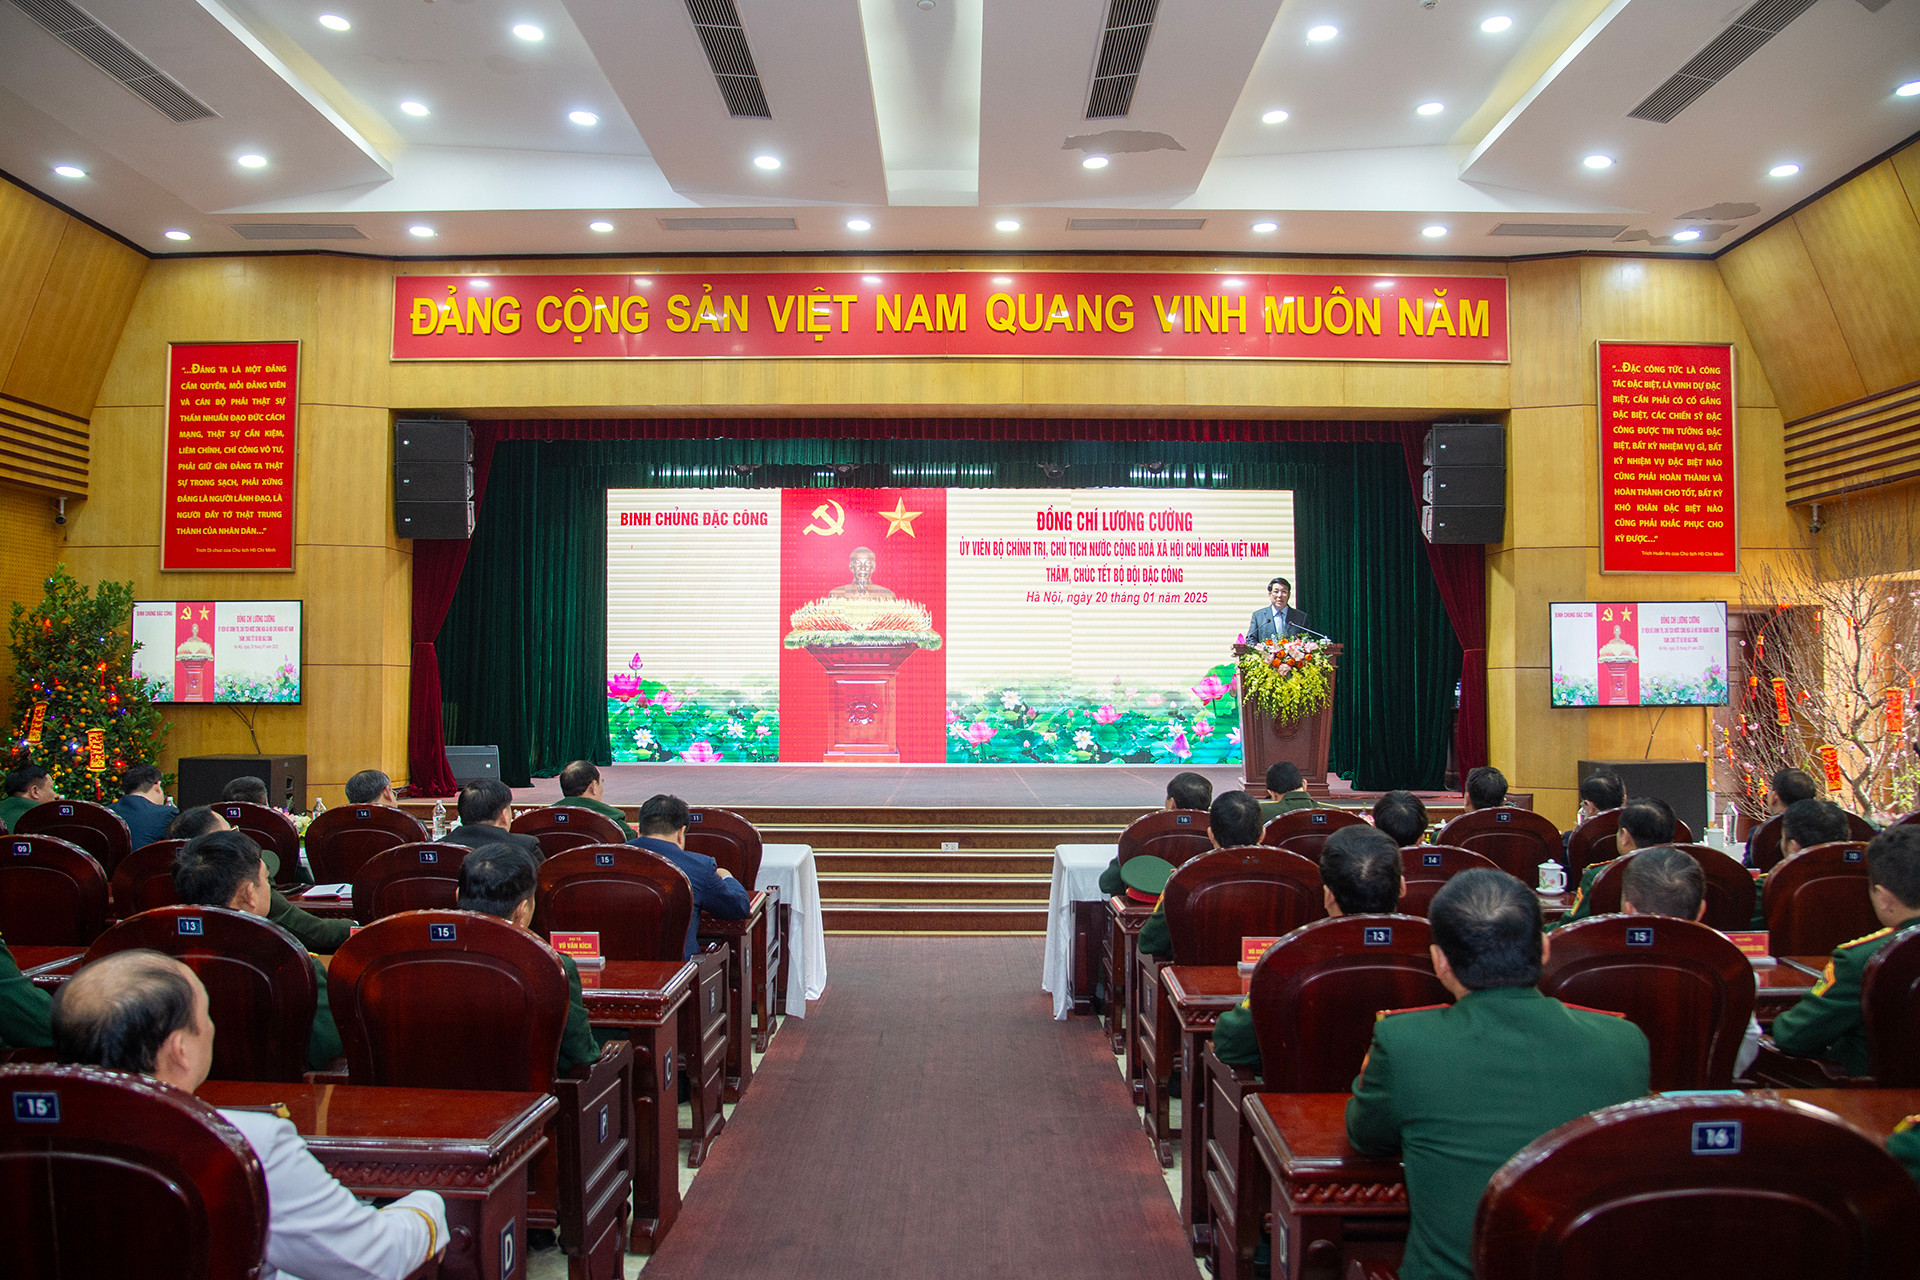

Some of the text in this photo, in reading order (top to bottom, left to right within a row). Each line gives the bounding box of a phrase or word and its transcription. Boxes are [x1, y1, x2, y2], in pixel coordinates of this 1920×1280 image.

[410, 284, 1490, 342] ĐẢNG CỘNG SẢN VIỆT NAM QUANG VINH MUÔN NĂM
[232, 365, 241, 373] LÀ
[245, 365, 261, 374] MỘT
[265, 364, 286, 372] ĐẢNG
[1644, 365, 1665, 373] CÔNG
[1668, 365, 1683, 373] TỨC
[1687, 366, 1696, 374] LÀ
[1699, 366, 1720, 374] CÔNG
[216, 398, 226, 406] BỘ
[231, 397, 248, 405] PHẢI
[252, 397, 270, 406] THẬT
[276, 397, 286, 406] SỰ
[1613, 410, 1628, 420] ĐẶC
[1631, 410, 1648, 420] BIỆT,
[1651, 411, 1666, 419] CÁC
[1706, 412, 1721, 422] ĐẶC
[179, 431, 203, 439] MẠNG,
[207, 430, 225, 439] THẬT
[230, 430, 240, 438] SỰ
[265, 429, 284, 438] KIỆM,
[1613, 425, 1634, 434] CÔNG
[1637, 426, 1659, 436] ĐƯỢC
[1677, 426, 1703, 435] TƯỞNG
[1706, 427, 1722, 437] ĐẶC
[178, 462, 195, 470] PHẢI
[214, 462, 227, 470] GÌN
[230, 461, 251, 469] ĐẢNG
[265, 461, 283, 470] THẬT
[1627, 457, 1651, 466] NHIỆM
[1654, 458, 1664, 467] VỤ
[1668, 457, 1683, 467] ĐẶC
[1687, 458, 1702, 467] BIỆT
[1706, 458, 1722, 466] NÀO
[178, 479, 188, 487] SỰ
[218, 479, 238, 487] SẠCH,
[242, 477, 259, 485] PHẢI
[1639, 472, 1656, 480] PHẢI
[1660, 473, 1681, 481] HOÀN
[1684, 473, 1710, 481] THÀNH
[1615, 503, 1631, 511] KHÓ
[1664, 503, 1679, 513] ĐẶC
[1685, 504, 1701, 513] BIỆT
[1707, 504, 1723, 512] NÀO
[236, 510, 254, 519] THẬT
[621, 507, 767, 528] BINH CHỦNG ĐẶC CÔNG
[1037, 505, 1192, 531] ĐỒNG CHÍ LƯƠNG CƯỜNG
[1639, 518, 1657, 527] PHẢI
[1684, 521, 1704, 529] PHỤC
[203, 526, 217, 534] CỦA
[960, 536, 970, 555] ỦY
[972, 538, 990, 555] VIÊN
[993, 538, 1004, 559] BỘ
[1006, 539, 1031, 556] CHÍNH
[1033, 542, 1048, 559] TRỊ,
[1051, 537, 1066, 556] CHỦ
[1069, 542, 1087, 559] TỊCH
[1089, 539, 1111, 556] NƯỚC
[1114, 539, 1136, 559] CỘNG
[1157, 539, 1167, 556] XÃ
[1170, 539, 1183, 560] HỘI
[1186, 538, 1202, 557] CHỦ
[1231, 539, 1248, 560] VIỆT
[1250, 543, 1269, 557] NAM
[1046, 563, 1183, 585] THĂM, CHÚC TẾT BỘ ĐỘI ĐẶC CÔNG
[1026, 591, 1207, 605] Hà Nội, ngày 20 tháng 01 năm 2025
[28, 1098, 49, 1116] 15
[1706, 1128, 1730, 1148] 16
[505, 1233, 513, 1270] D
